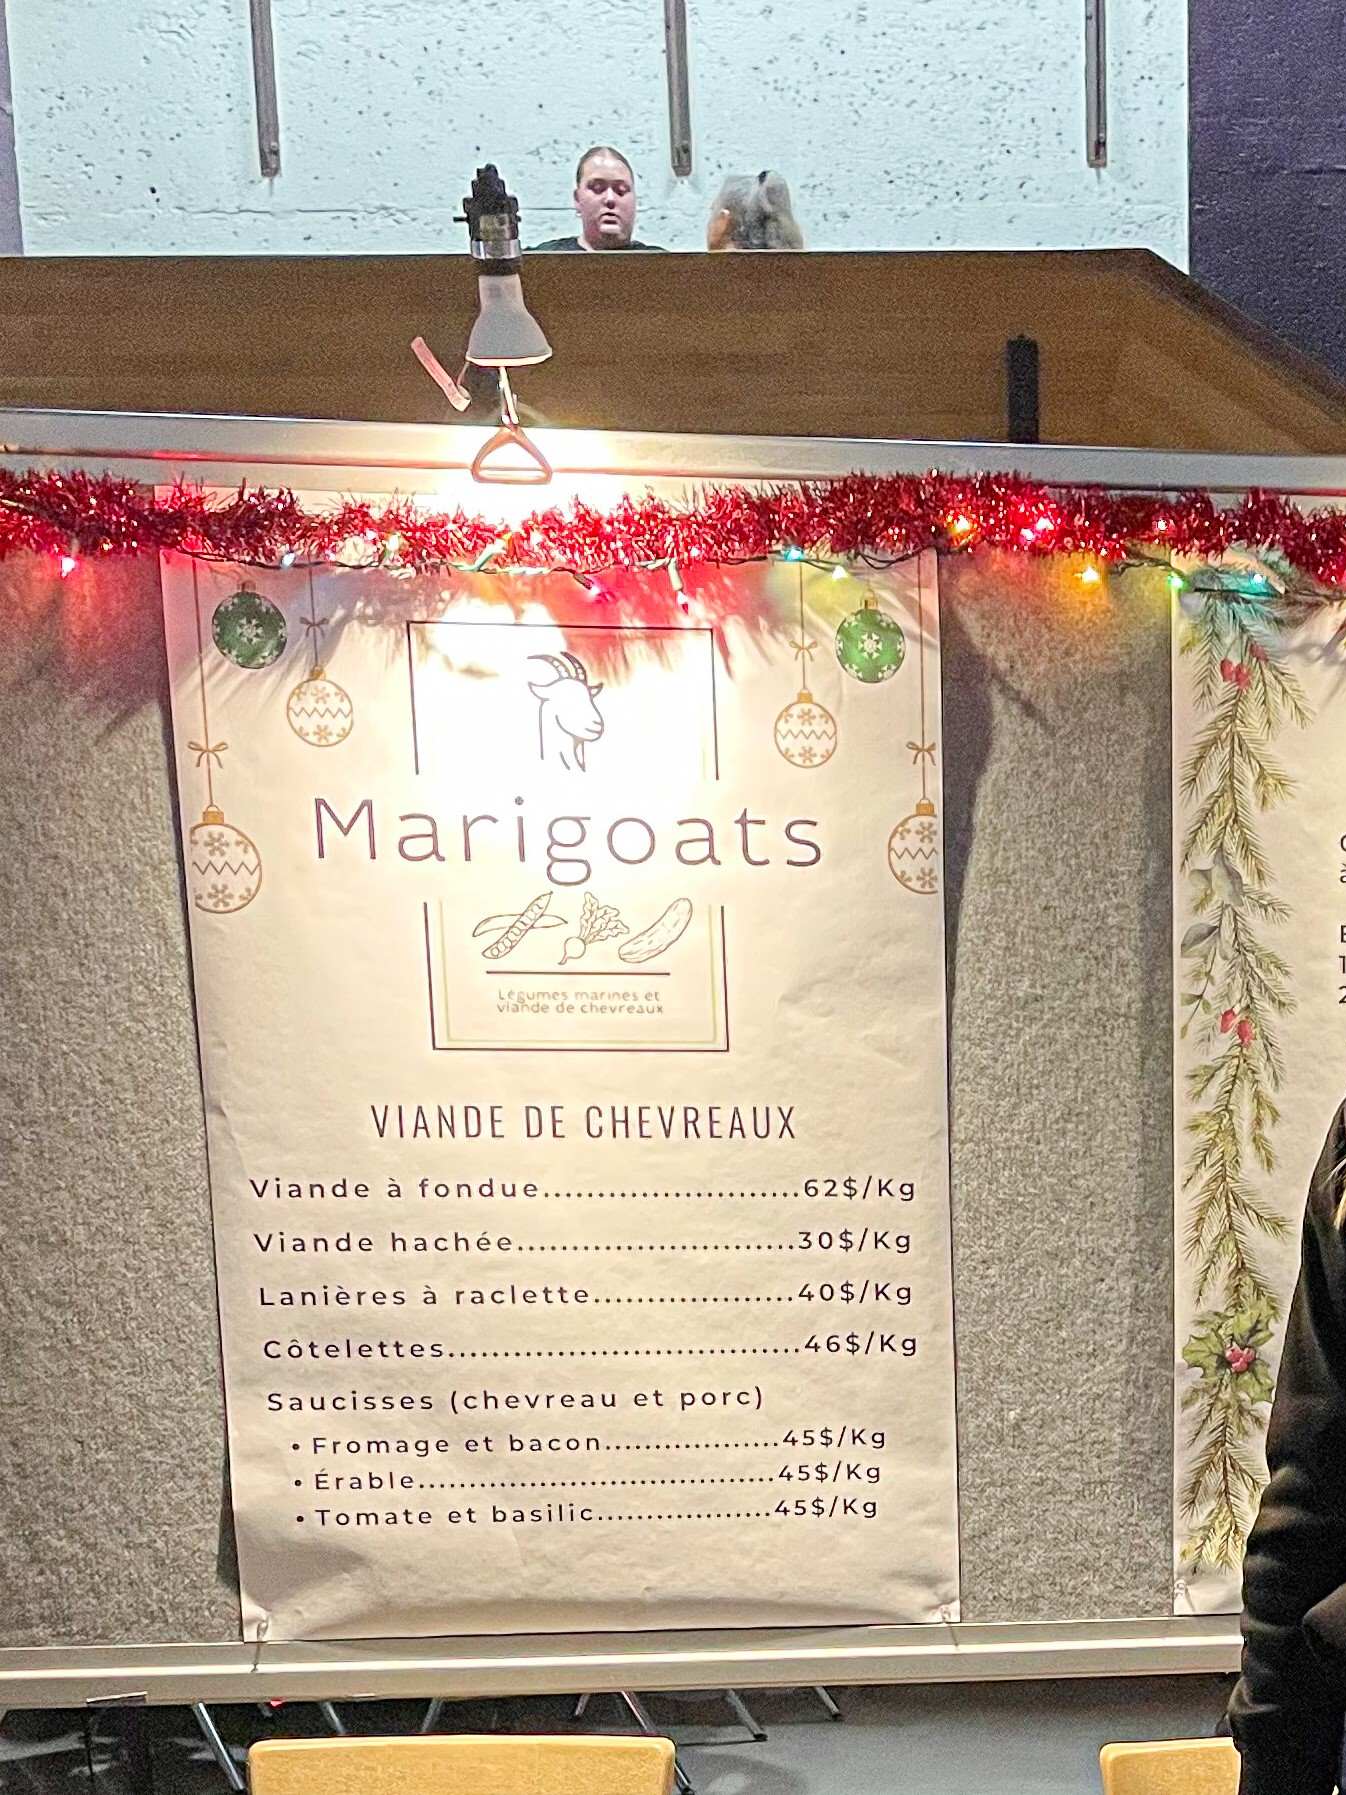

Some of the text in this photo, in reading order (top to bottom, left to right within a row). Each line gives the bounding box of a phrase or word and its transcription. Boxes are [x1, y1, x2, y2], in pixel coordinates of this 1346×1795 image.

[314, 795, 822, 886] Marigoats
[1339, 955, 1346, 974] 1
[498, 989, 660, 1003] Légumes marines et
[497, 1001, 663, 1014] viande de chevreaux
[370, 1104, 797, 1140] VIANDE DE CHEVREAUX
[249, 1179, 371, 1199] Viande
[386, 1178, 401, 1199] à
[253, 1232, 374, 1253] Viande
[259, 1286, 407, 1306] Lanières
[422, 1285, 438, 1306] à
[267, 1385, 763, 1415] Saucisses (chevreau et porc)
[312, 1435, 450, 1458] Fromage
[464, 1434, 495, 1453] et
[314, 1507, 434, 1527] Tomate
[448, 1506, 478, 1526] et
